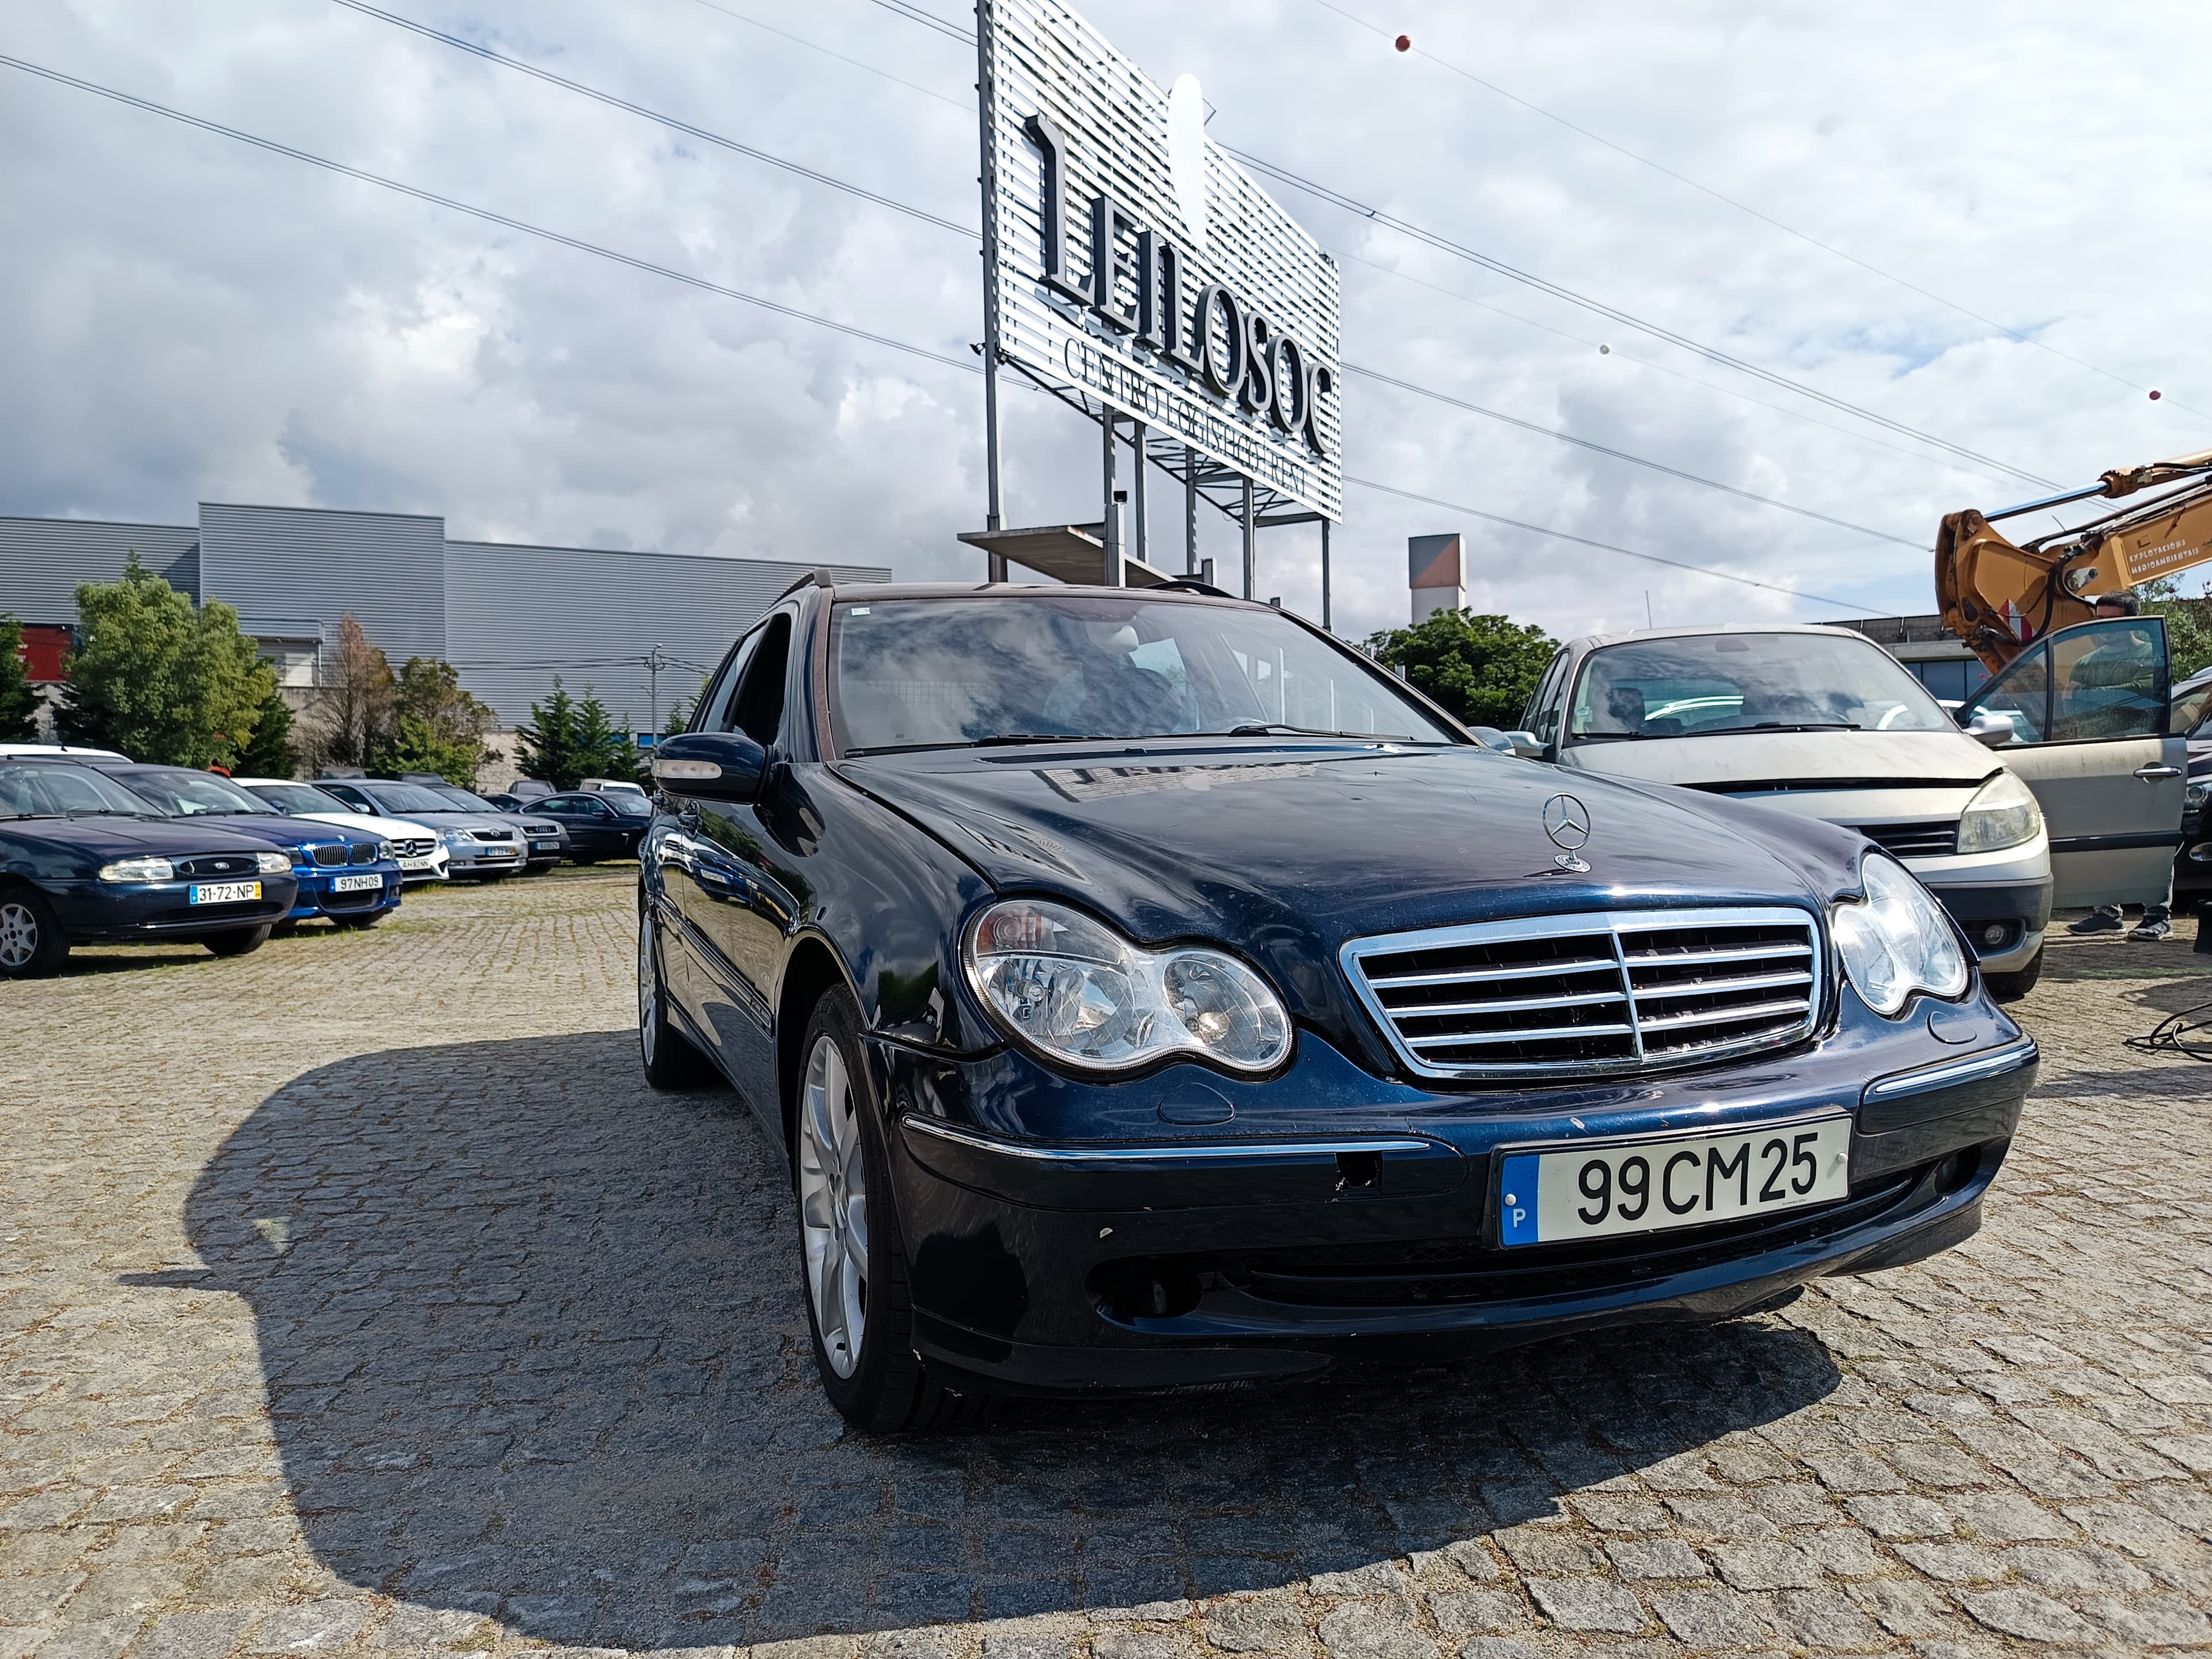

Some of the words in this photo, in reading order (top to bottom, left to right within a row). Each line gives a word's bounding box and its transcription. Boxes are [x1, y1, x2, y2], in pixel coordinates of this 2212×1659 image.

[1025, 115, 1334, 454] LEILOSOC
[1065, 338, 1158, 419] CENTRO
[1271, 452, 1308, 498] RENT
[341, 876, 378, 889] 97NH09
[1513, 1209, 1526, 1228] P
